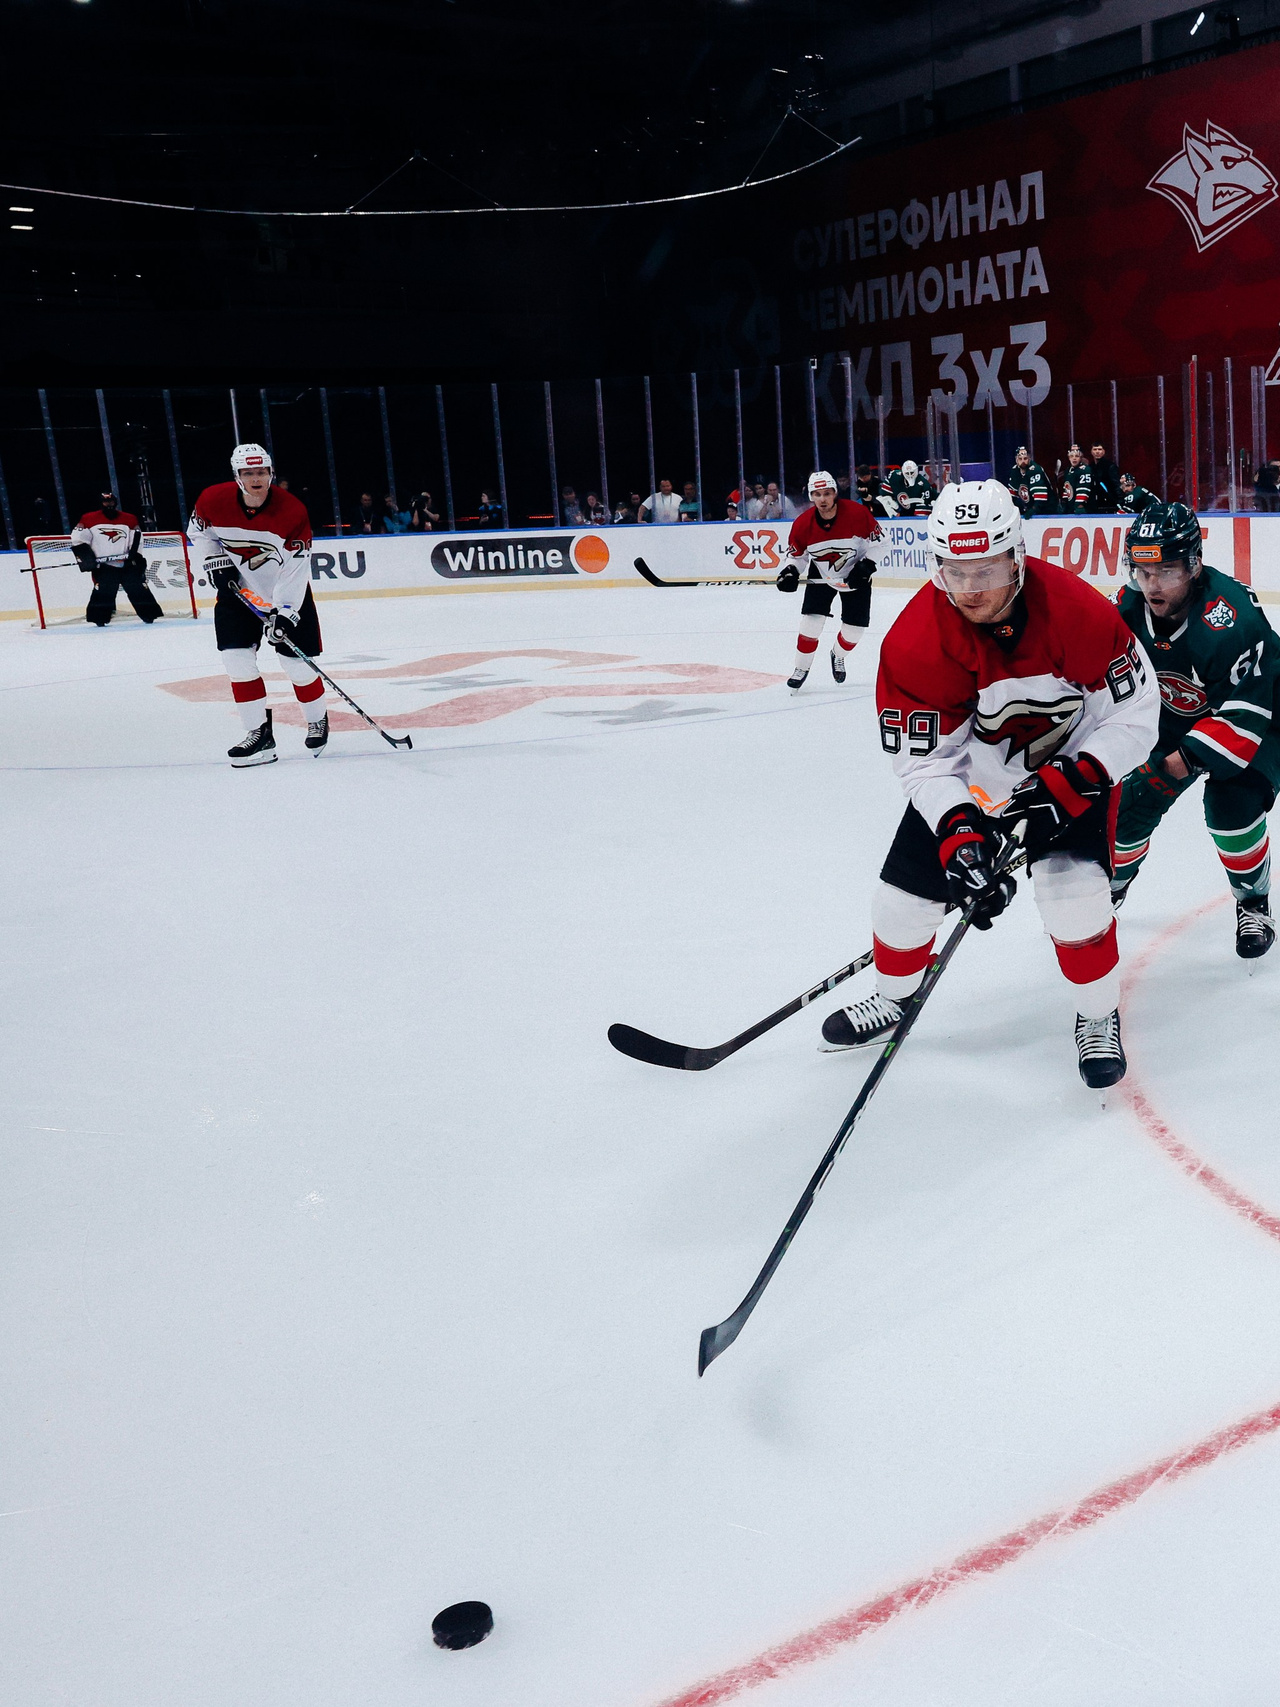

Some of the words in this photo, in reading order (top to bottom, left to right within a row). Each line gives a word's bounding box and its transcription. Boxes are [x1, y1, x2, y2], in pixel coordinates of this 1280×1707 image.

[793, 170, 1046, 270] СУПЕРФИНАЛ
[796, 246, 1049, 331] ЧЕМПИОНАТА
[1079, 473, 1092, 484] 25
[950, 537, 987, 548] FONBET
[1139, 523, 1156, 538] 61
[443, 544, 564, 573] Winline
[1229, 640, 1265, 686] 61
[880, 708, 941, 757] 69
